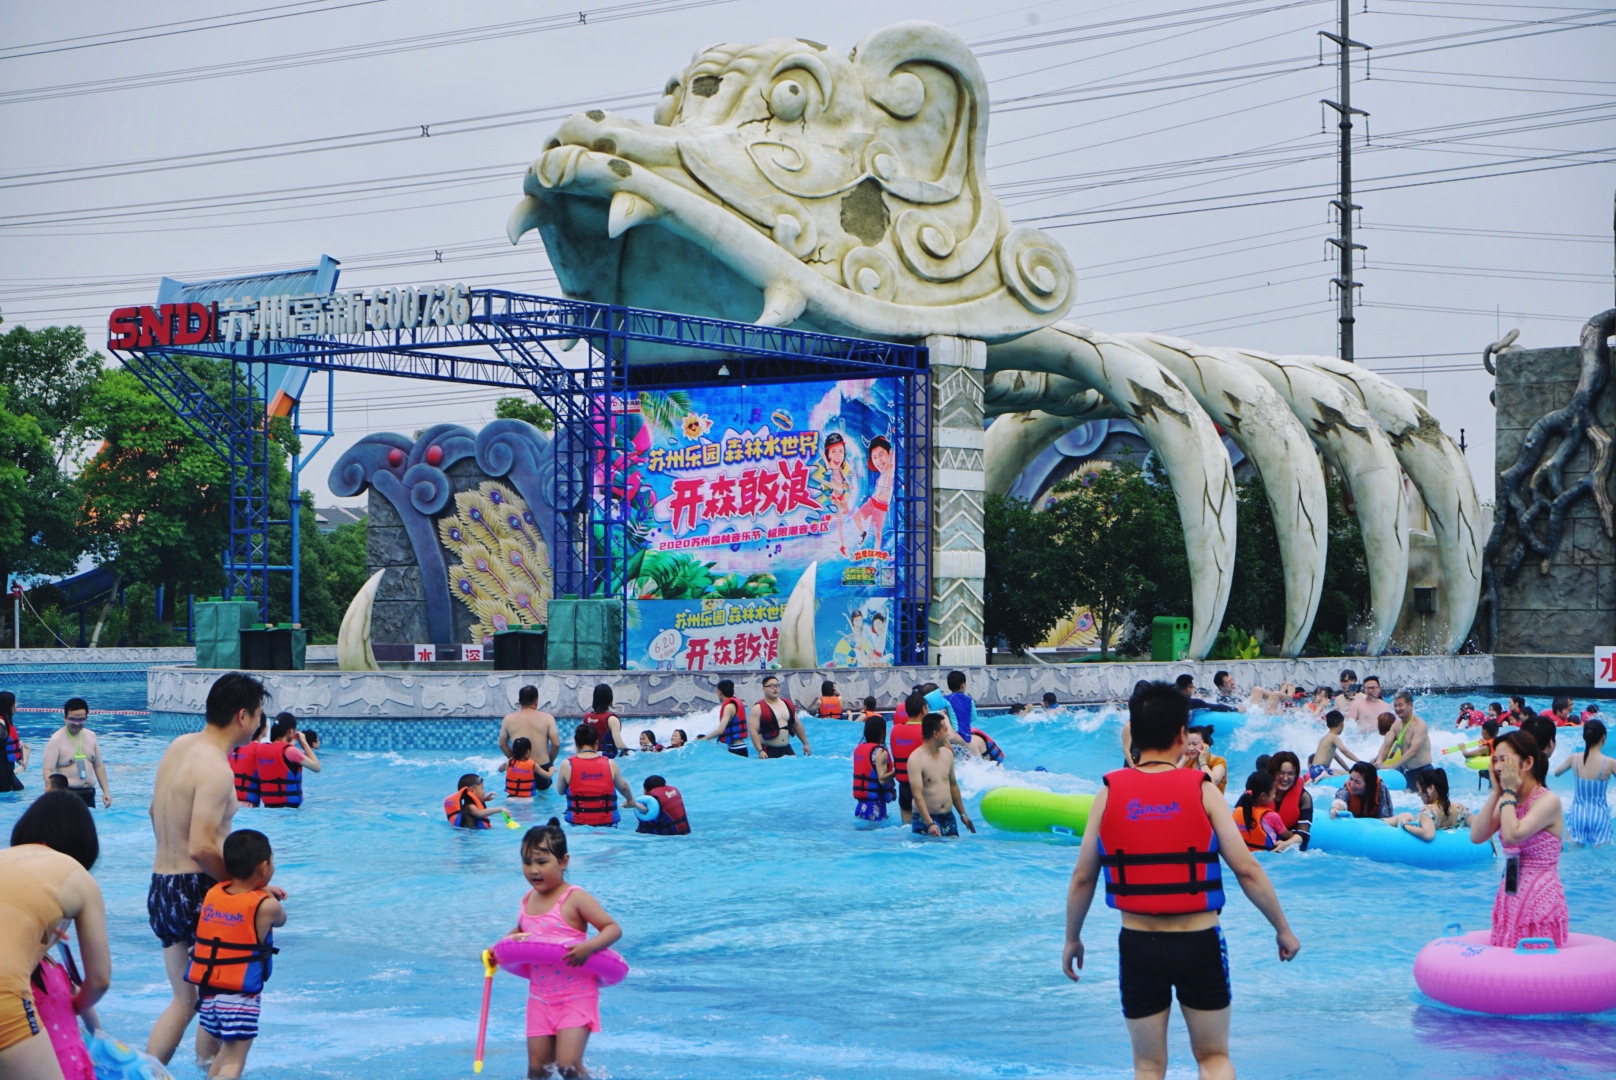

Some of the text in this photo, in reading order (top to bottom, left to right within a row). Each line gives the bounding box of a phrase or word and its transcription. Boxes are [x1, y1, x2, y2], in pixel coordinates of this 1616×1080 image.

[219, 290, 366, 342] 苏州高新
[371, 282, 470, 330] 600736
[648, 432, 819, 472] 苏州乐园 森林水世界
[669, 460, 823, 532] 开森敢浪
[675, 610, 727, 630] 苏州乐园
[417, 648, 433, 662] 水
[654, 633, 675, 654] 6.20
